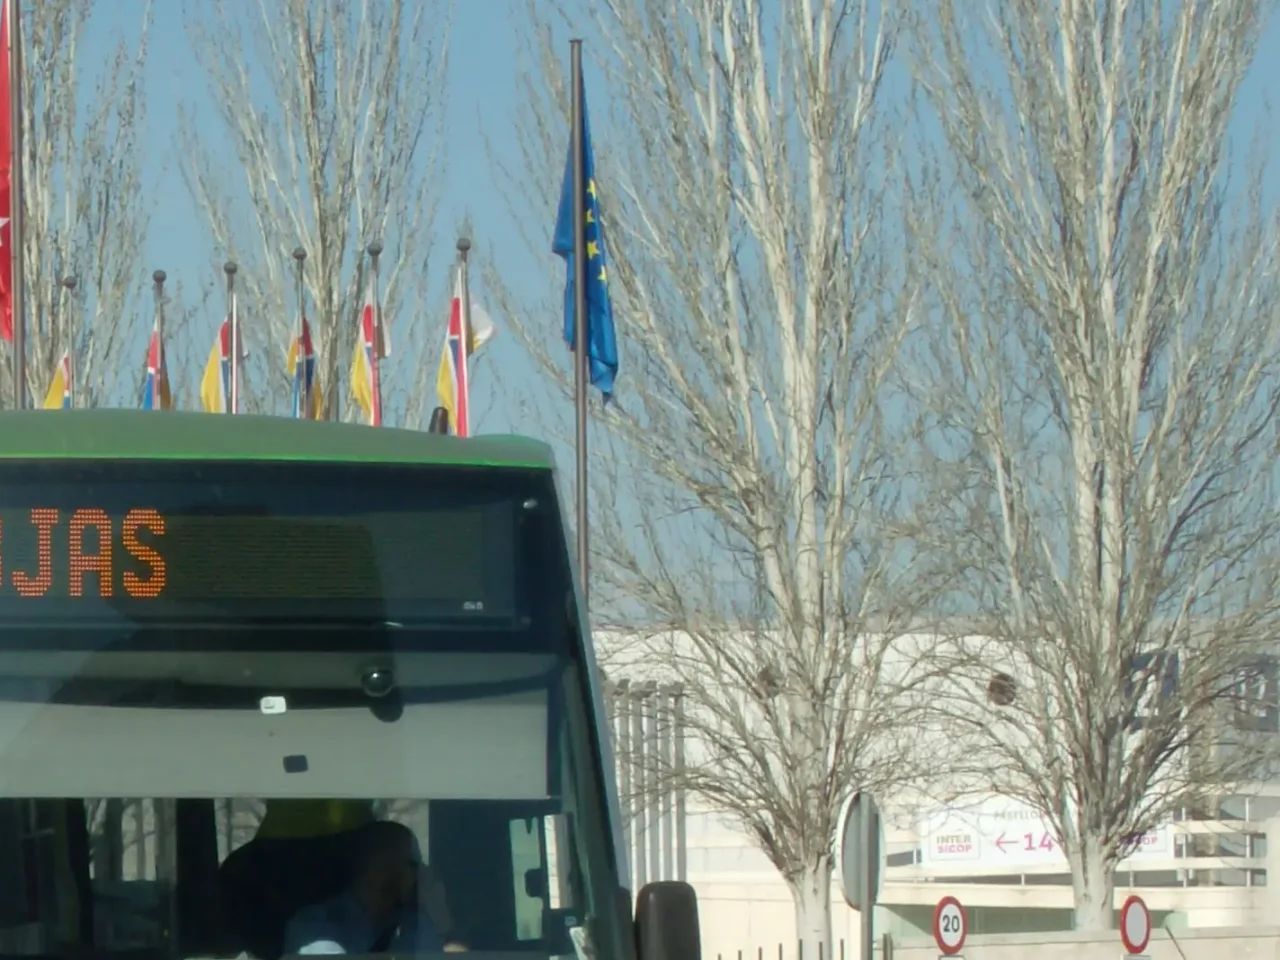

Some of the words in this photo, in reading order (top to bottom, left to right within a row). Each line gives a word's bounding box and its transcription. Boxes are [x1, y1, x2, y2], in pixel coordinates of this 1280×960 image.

[936, 835, 972, 844] INTER
[1024, 832, 1054, 852] 14
[942, 914, 960, 933] 20
